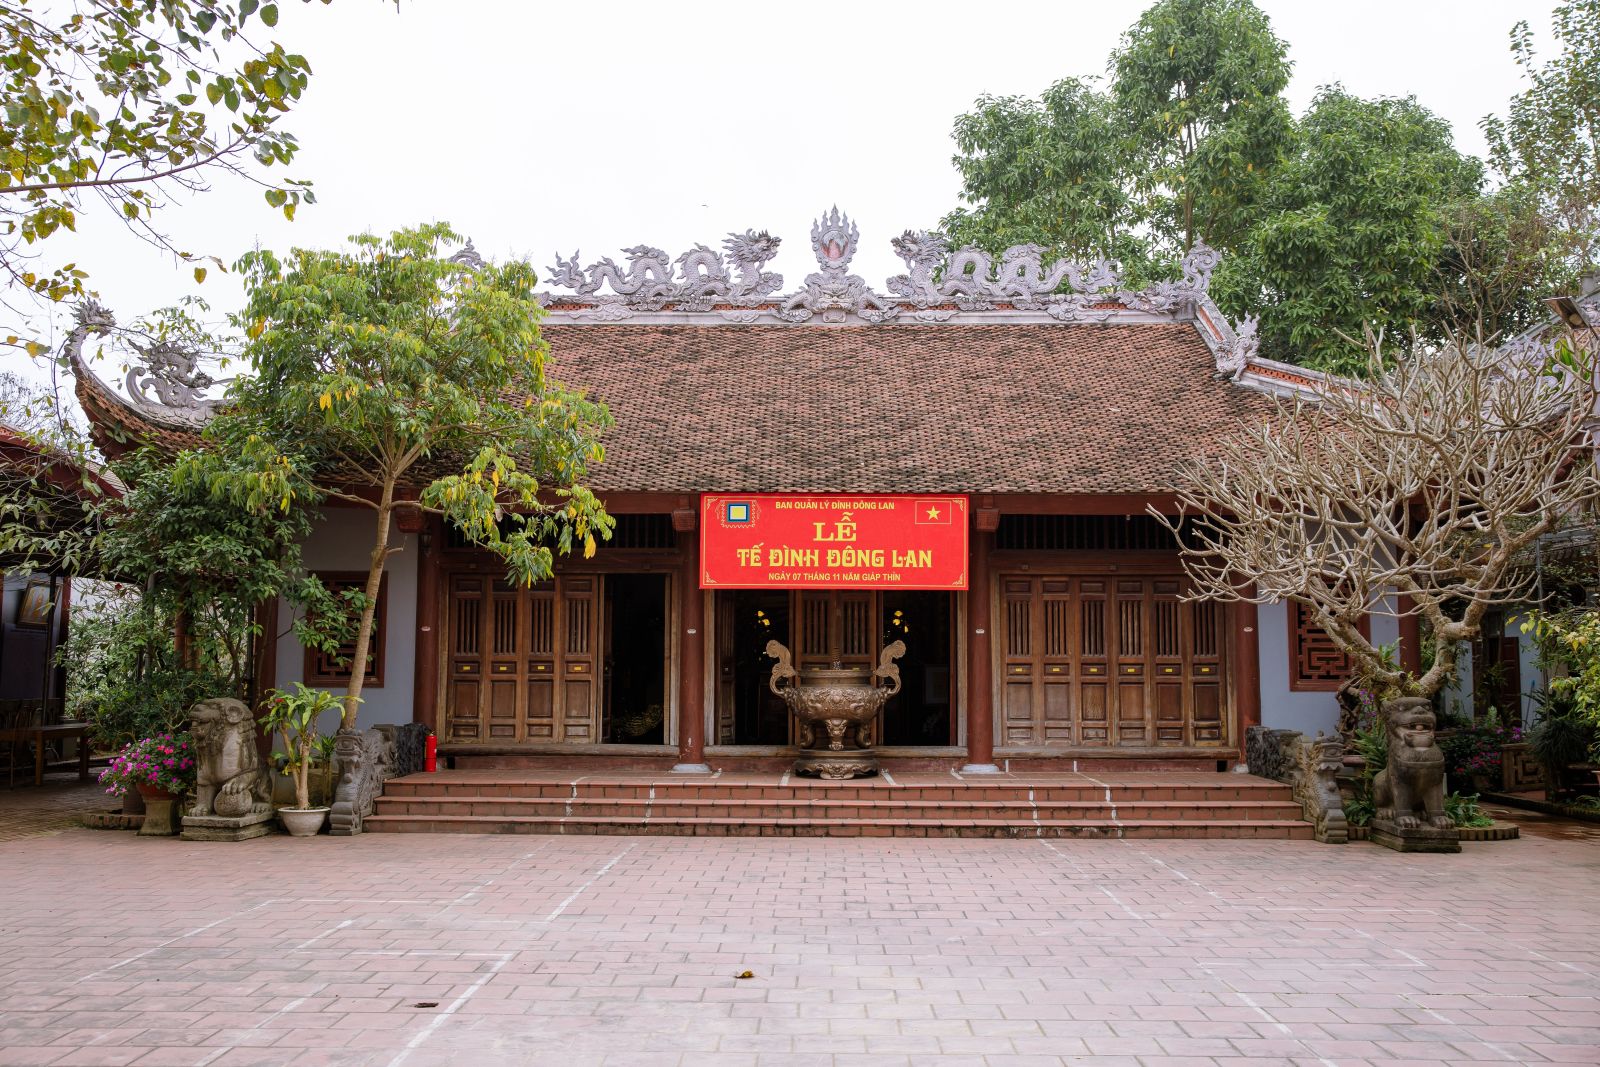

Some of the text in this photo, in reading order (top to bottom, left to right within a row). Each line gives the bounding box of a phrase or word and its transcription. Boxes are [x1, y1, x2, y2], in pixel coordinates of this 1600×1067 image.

[775, 499, 895, 510] BAN QUẢN LÝ ĐÌNH ĐÔNG LAN
[813, 511, 857, 541] LỄ
[736, 542, 933, 568] TẾ ĐÌNH ĐÔNG LAN
[768, 571, 901, 581] NGÀY 07 THÁNG 11 NĂM GIÁP THÌN
